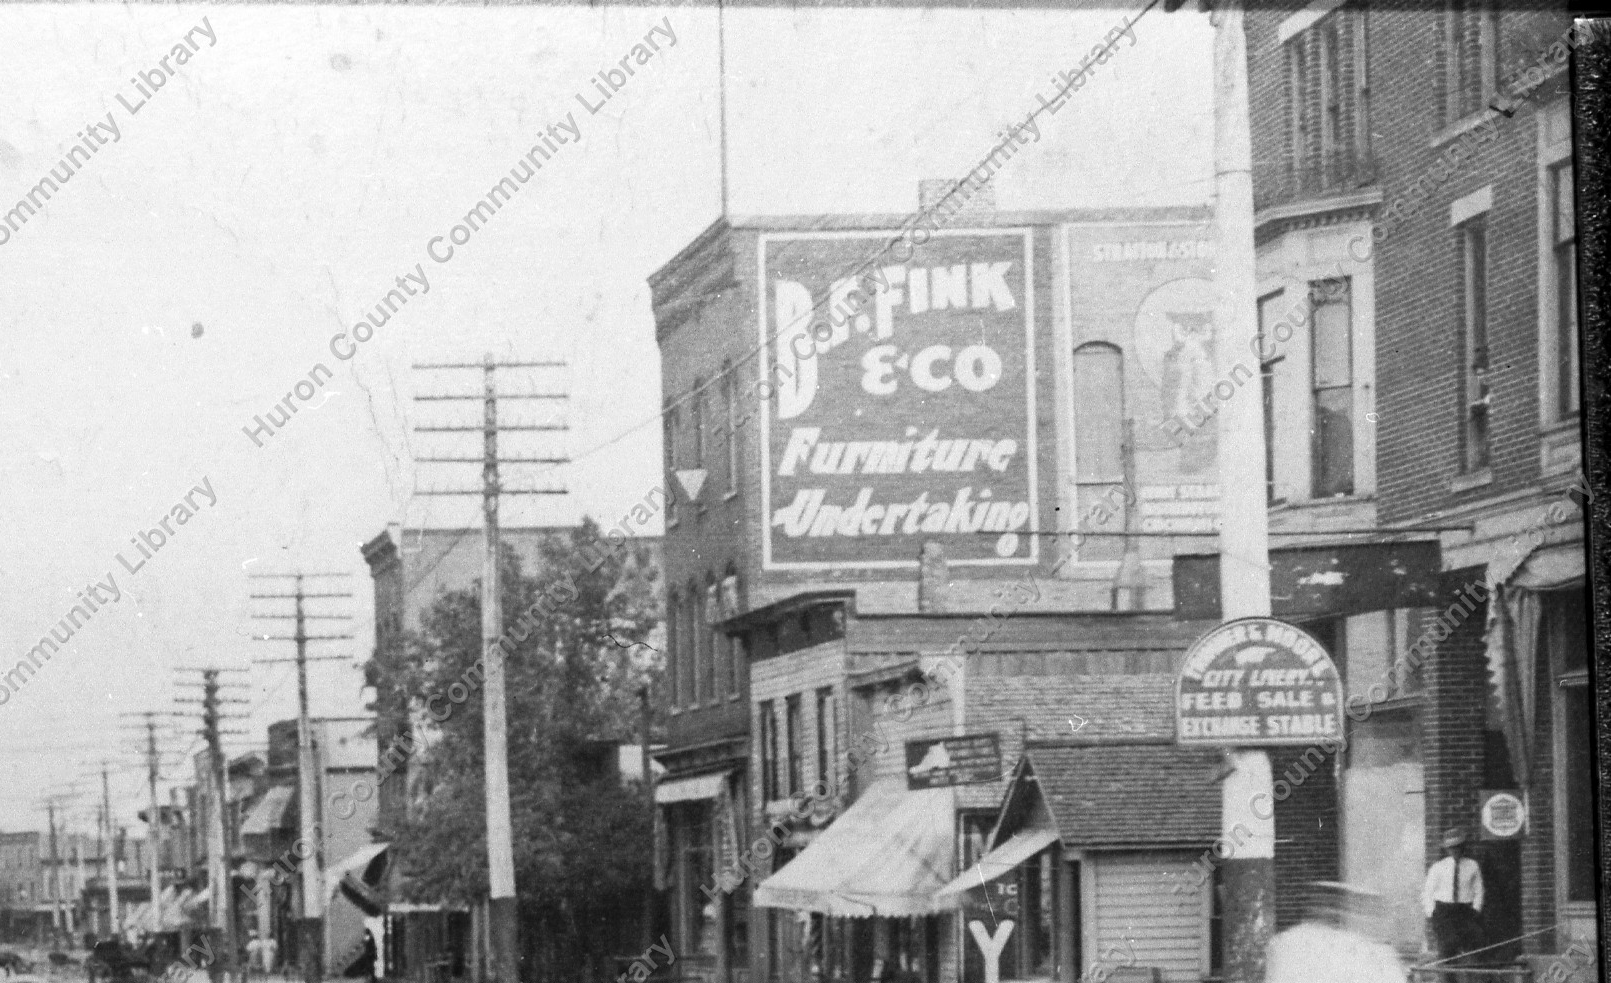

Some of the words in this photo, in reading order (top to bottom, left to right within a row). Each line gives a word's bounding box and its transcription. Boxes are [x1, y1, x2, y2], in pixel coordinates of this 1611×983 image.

[874, 261, 1016, 341] FINK
[910, 345, 1002, 392] CO
[777, 425, 1018, 476] Furniture
[771, 486, 1029, 558] Undertaking
[1182, 692, 1242, 709] FEED
[1257, 691, 1314, 708] SALE
[1203, 670, 1245, 688] CITY
[1181, 717, 1260, 735] EXCHANGE
[1267, 715, 1336, 734] STABLE
